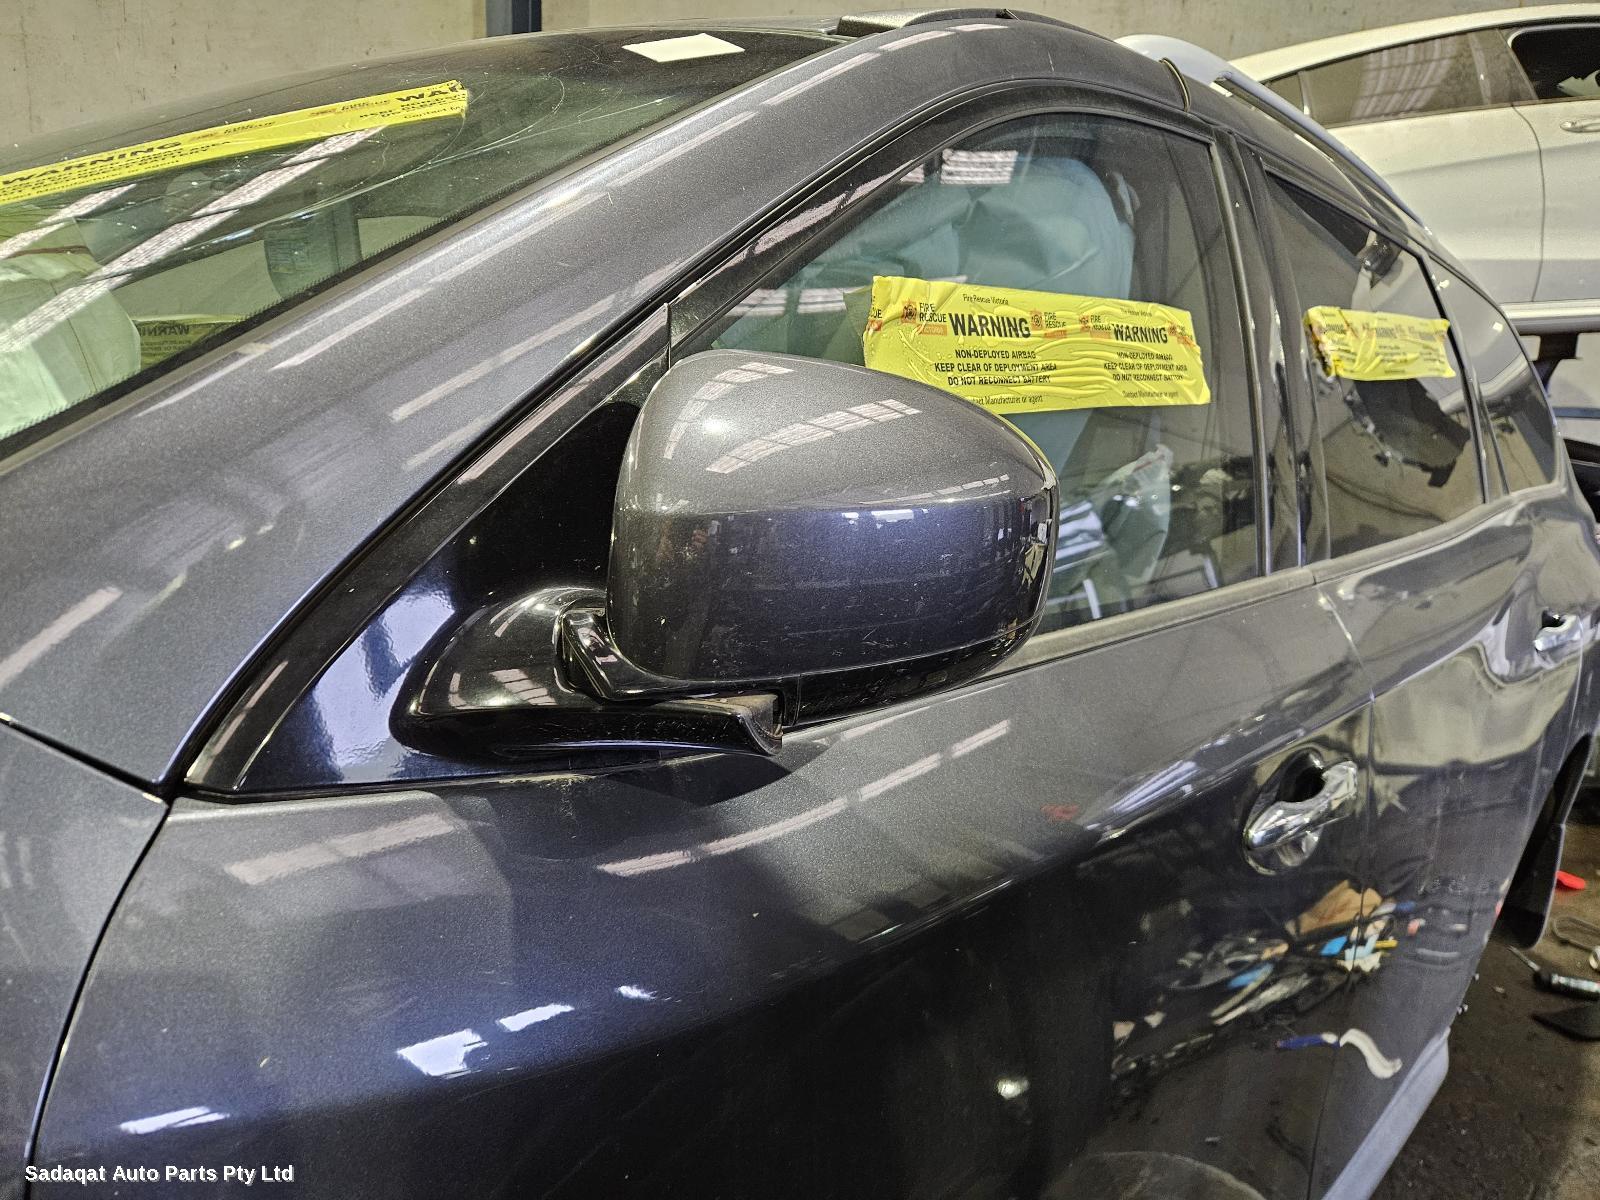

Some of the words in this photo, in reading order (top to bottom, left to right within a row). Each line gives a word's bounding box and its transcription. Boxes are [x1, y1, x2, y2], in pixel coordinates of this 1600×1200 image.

[2, 140, 182, 185] WARNING
[919, 302, 936, 312] FIRE
[919, 313, 947, 323] RESCUE
[1044, 312, 1057, 321] FIRE
[948, 313, 1031, 338] WARNING
[1112, 323, 1168, 344] WARNING
[955, 349, 1010, 359] NON-DEPLOYED
[1012, 350, 1037, 359] AIRBAG
[934, 363, 955, 372] KEEP
[957, 363, 981, 372] CLEAR
[983, 363, 992, 371] OF
[994, 363, 1039, 372] DEPLOYMENT
[1040, 362, 1057, 371] AREA
[1144, 363, 1174, 371] DEPLOYMENT
[947, 376, 958, 385] DO
[961, 377, 976, 385] NOT
[979, 376, 1021, 385] RECONNECT
[1023, 375, 1051, 383] BATTERY
[1113, 373, 1120, 381] DO
